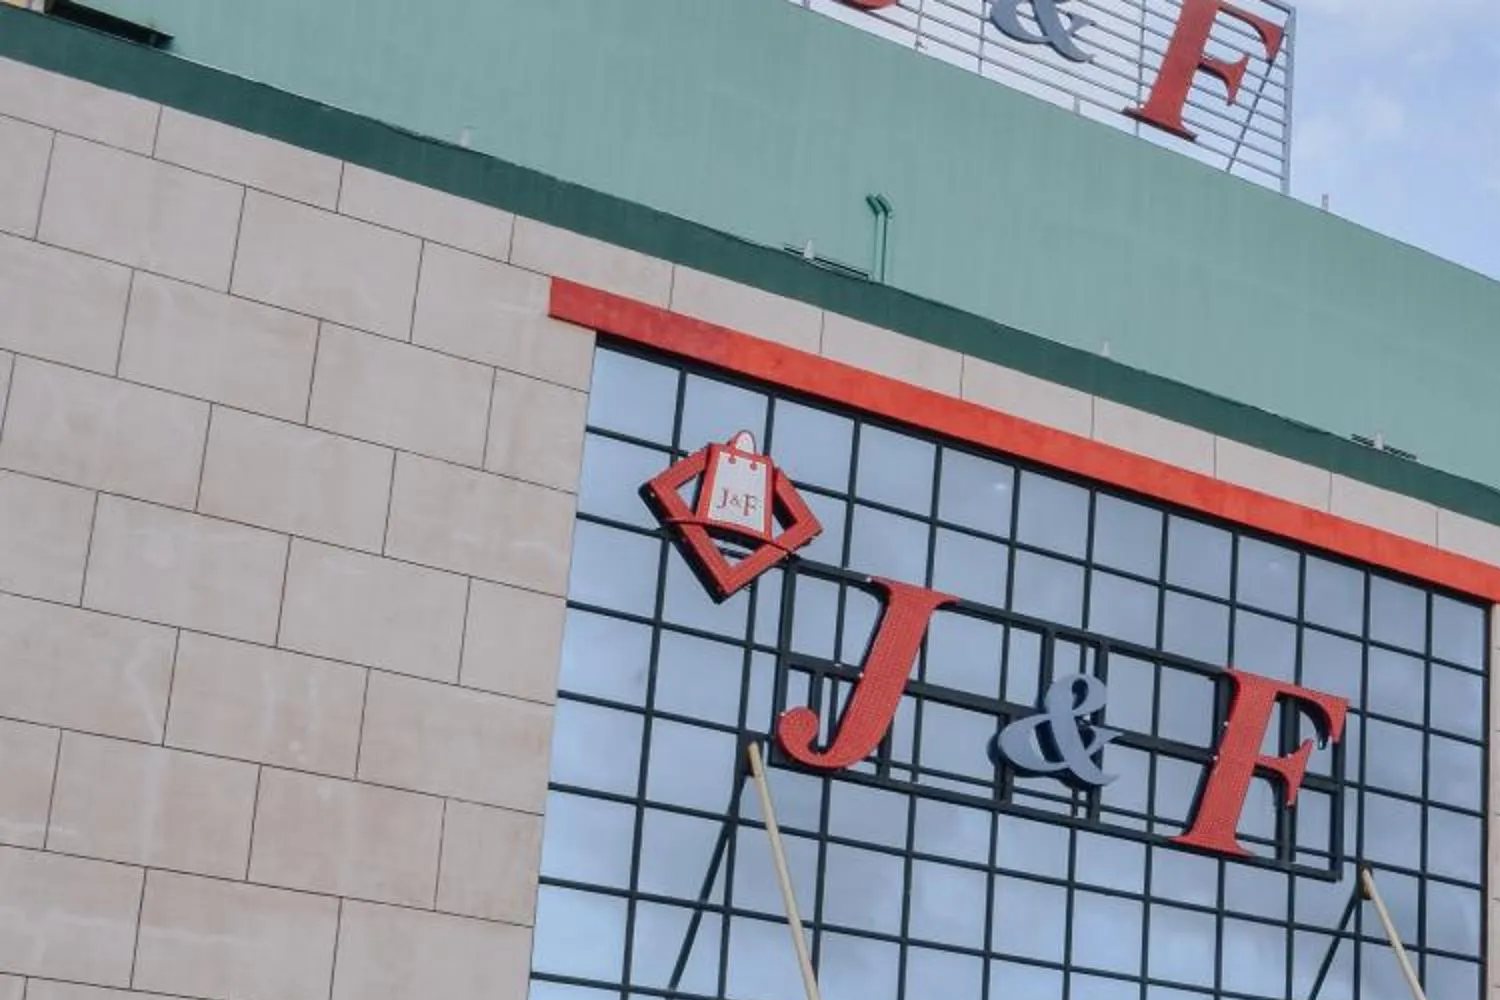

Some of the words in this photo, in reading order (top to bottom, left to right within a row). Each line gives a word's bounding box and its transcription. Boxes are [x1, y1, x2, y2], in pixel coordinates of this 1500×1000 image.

[1122, 0, 1284, 141] F
[775, 576, 961, 773] J
[988, 673, 1122, 787] &
[1168, 667, 1350, 857] F
